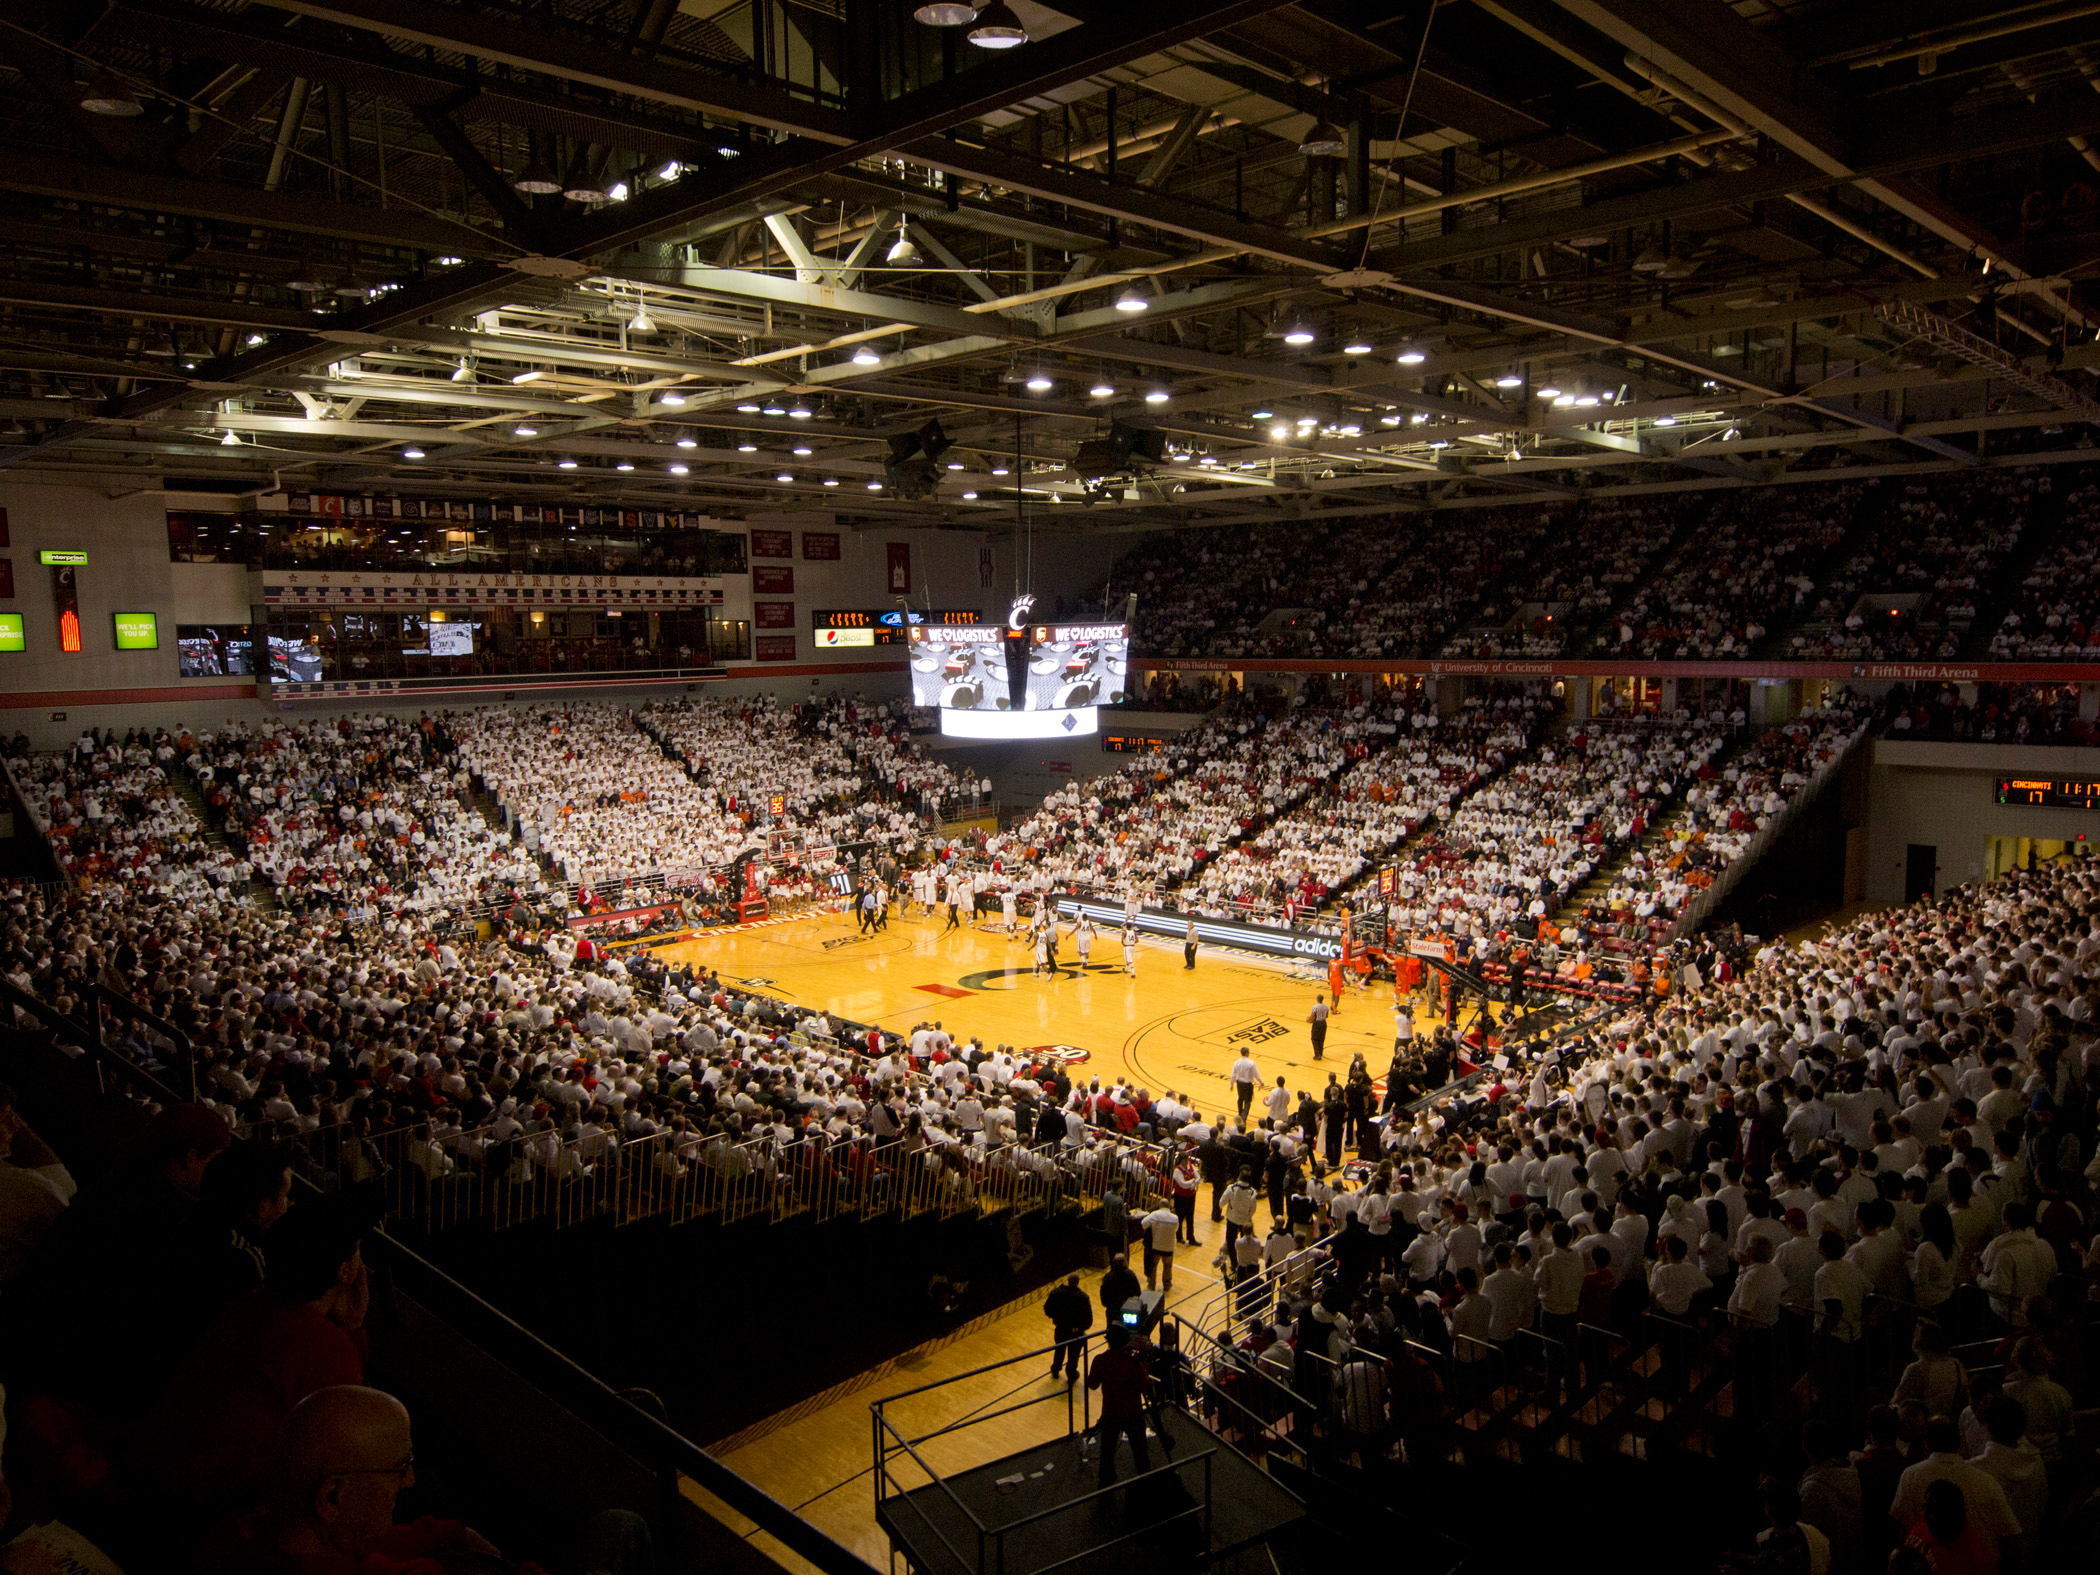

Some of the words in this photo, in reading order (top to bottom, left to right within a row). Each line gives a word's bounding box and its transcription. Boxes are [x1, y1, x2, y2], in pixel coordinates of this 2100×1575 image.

[412, 574, 618, 587] ALL-AMERICANS
[0, 631, 23, 639] RPRISE
[840, 633, 862, 643] pepsi
[928, 629, 945, 641] WE
[952, 629, 997, 642] LOGISTICS
[1055, 628, 1070, 641] WE
[1079, 626, 1122, 640] LOGISTICS
[1176, 661, 1191, 669] Fifth
[1192, 661, 1207, 669] Third
[1445, 662, 1489, 674] University
[1492, 662, 1502, 672] of
[1505, 662, 1553, 673] Cincinnati
[1872, 666, 1901, 677] Fifth
[1904, 666, 1936, 677] Third
[1939, 667, 1978, 678] Arena
[2012, 780, 2052, 790] CINCINNATI
[2029, 791, 2043, 804] 17
[772, 802, 784, 814] 35
[692, 909, 828, 939] CINCINNATI
[1412, 943, 1427, 951] State
[1427, 944, 1443, 953] Farm
[1042, 1044, 1088, 1059] 50
